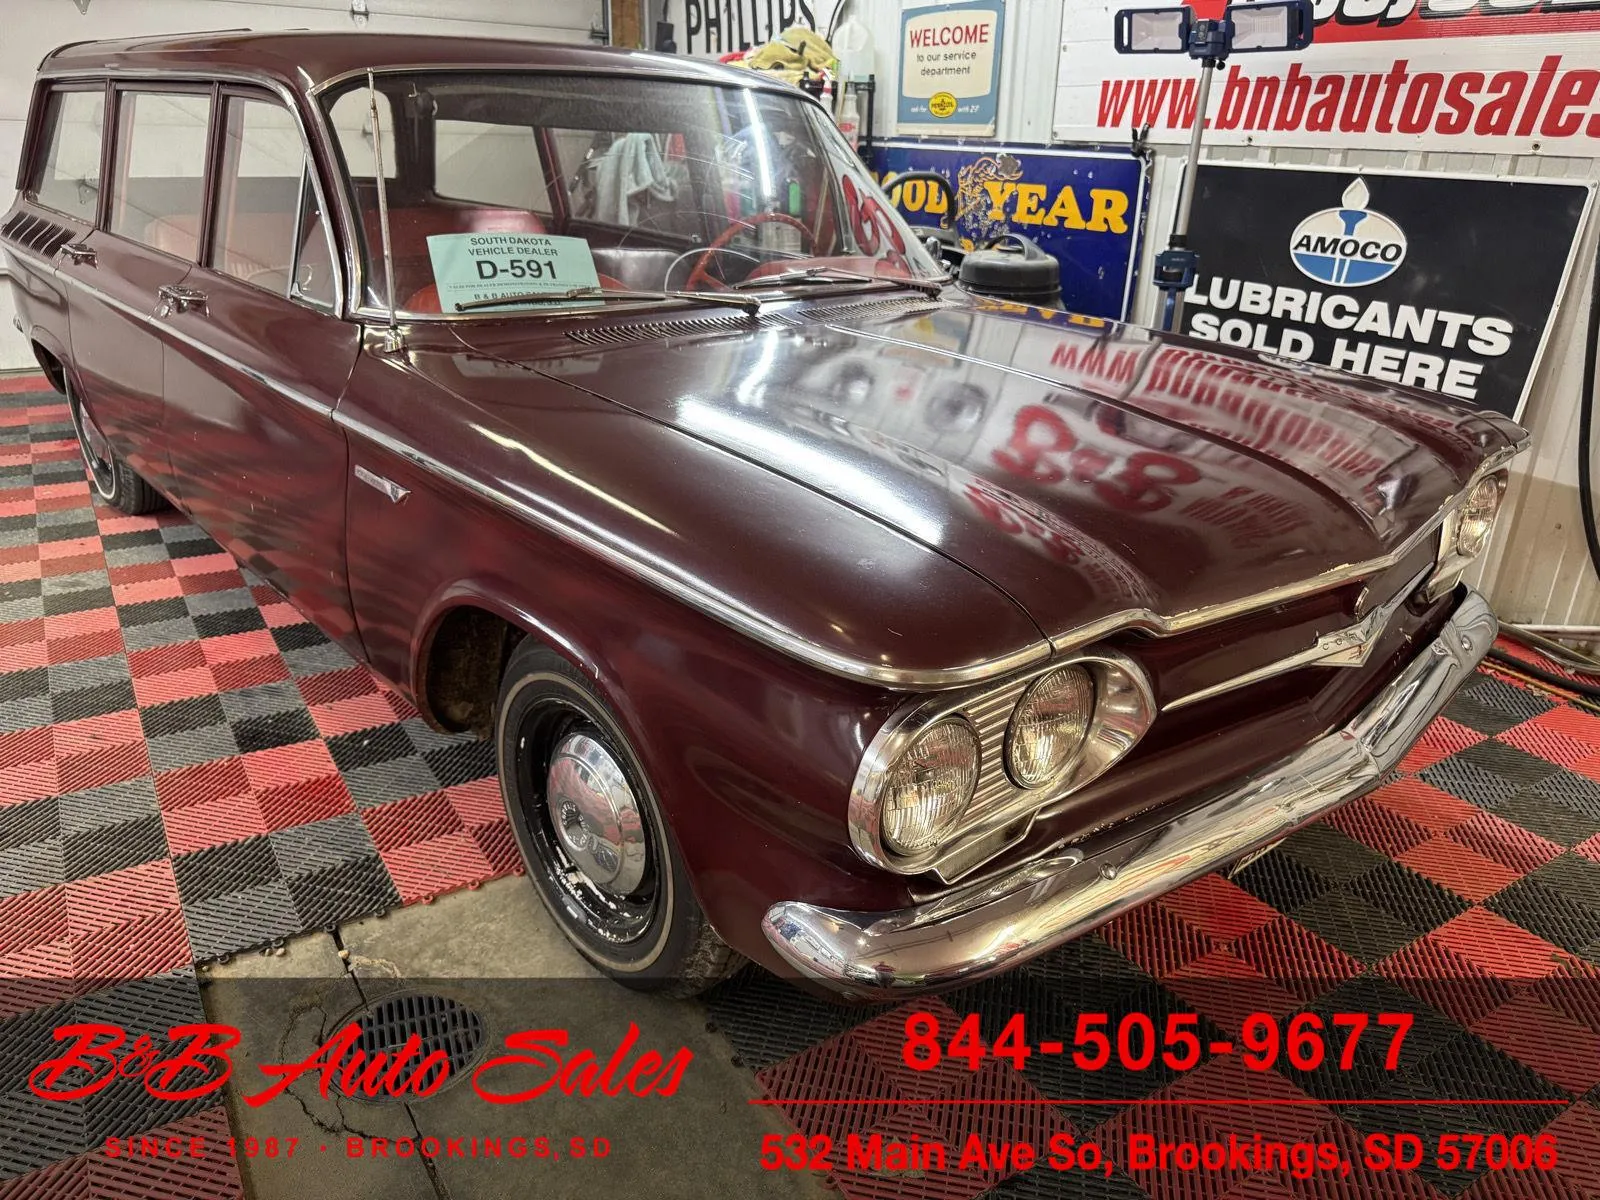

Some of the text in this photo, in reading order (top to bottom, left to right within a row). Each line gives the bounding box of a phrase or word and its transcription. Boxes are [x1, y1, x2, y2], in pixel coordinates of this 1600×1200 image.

[909, 24, 989, 48] WELCOME
[927, 53, 941, 62] our
[943, 51, 977, 61] service
[920, 66, 970, 76] department
[1097, 54, 1600, 138] www.bnbautosale
[983, 180, 1129, 234] YEAR
[468, 247, 559, 256] VEHICLE DEALER
[470, 237, 552, 246] SOUTH DAKOTA
[1293, 234, 1402, 263] AMOCO
[476, 259, 557, 280] D-591
[1183, 274, 1513, 357] LUBRICANTS
[1189, 312, 1314, 363] SOLD
[1330, 338, 1484, 400] HERE
